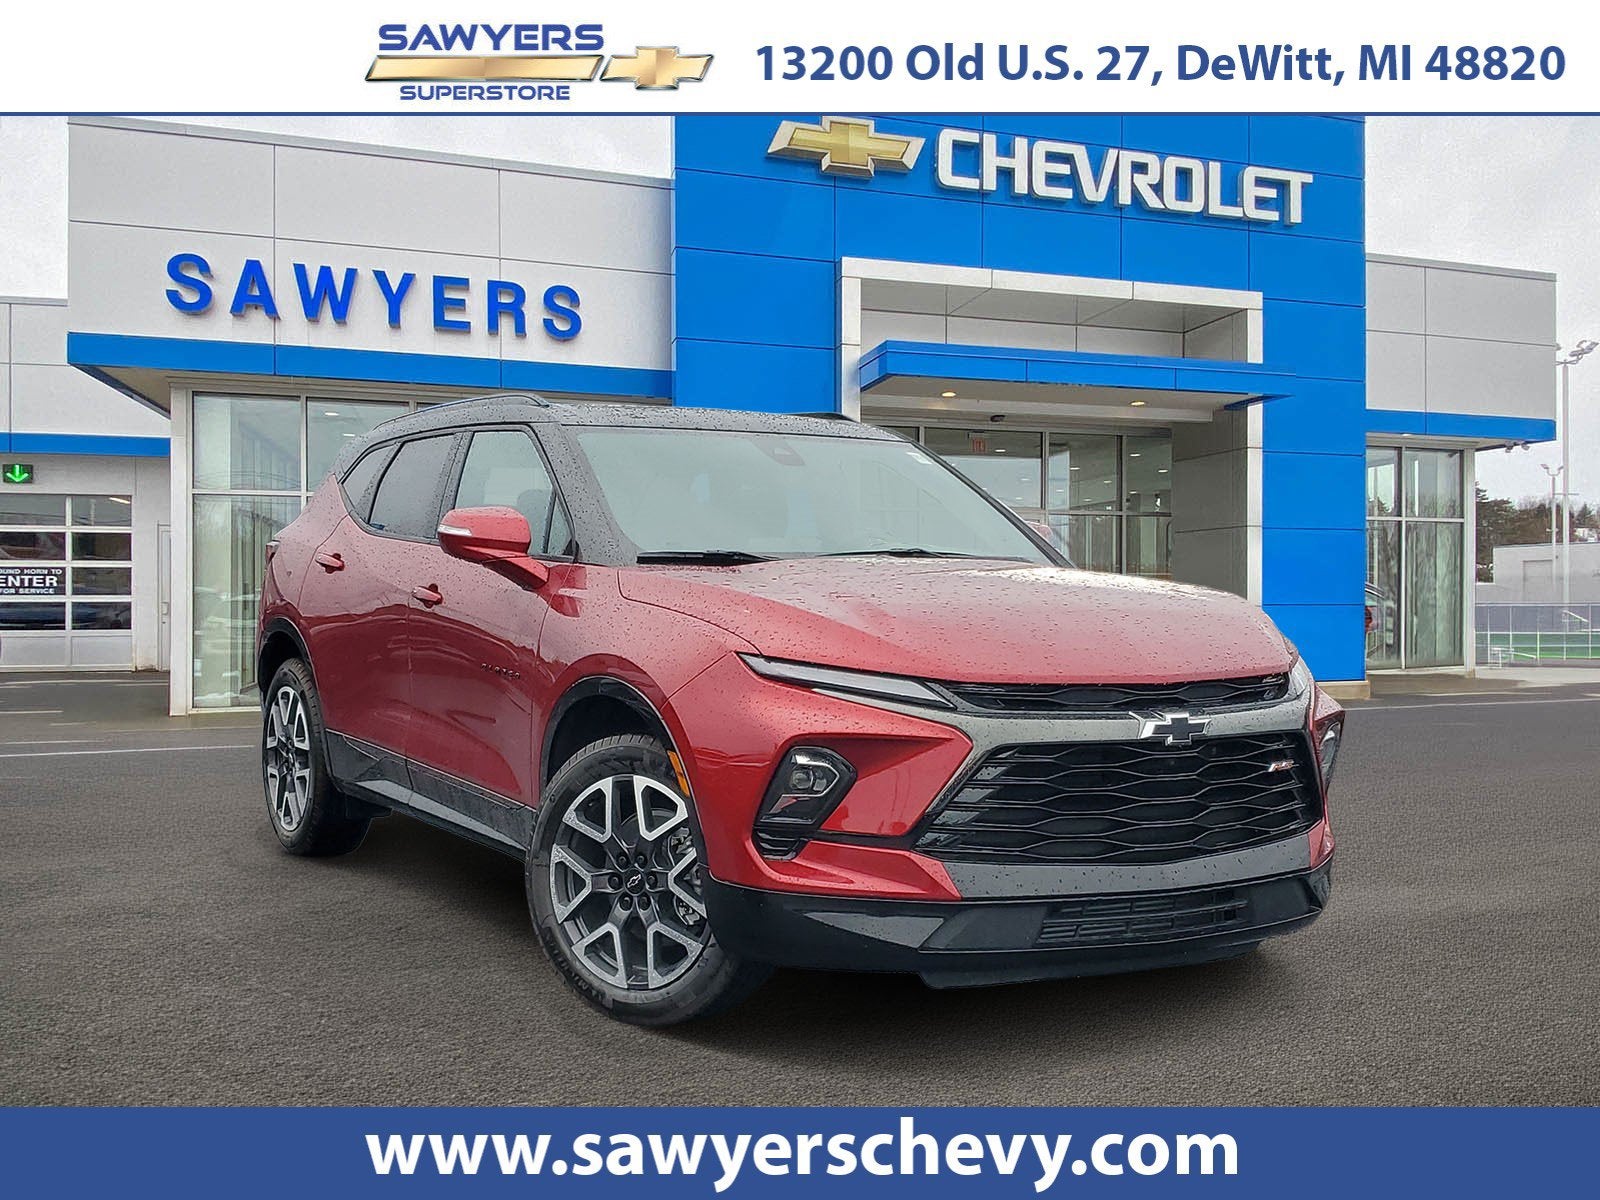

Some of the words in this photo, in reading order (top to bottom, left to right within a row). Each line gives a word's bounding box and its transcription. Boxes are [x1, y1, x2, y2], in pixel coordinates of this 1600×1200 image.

[935, 127, 1314, 225] CHEVROLET
[165, 253, 583, 342] SAWYERS
[0, 575, 58, 587] ENTER
